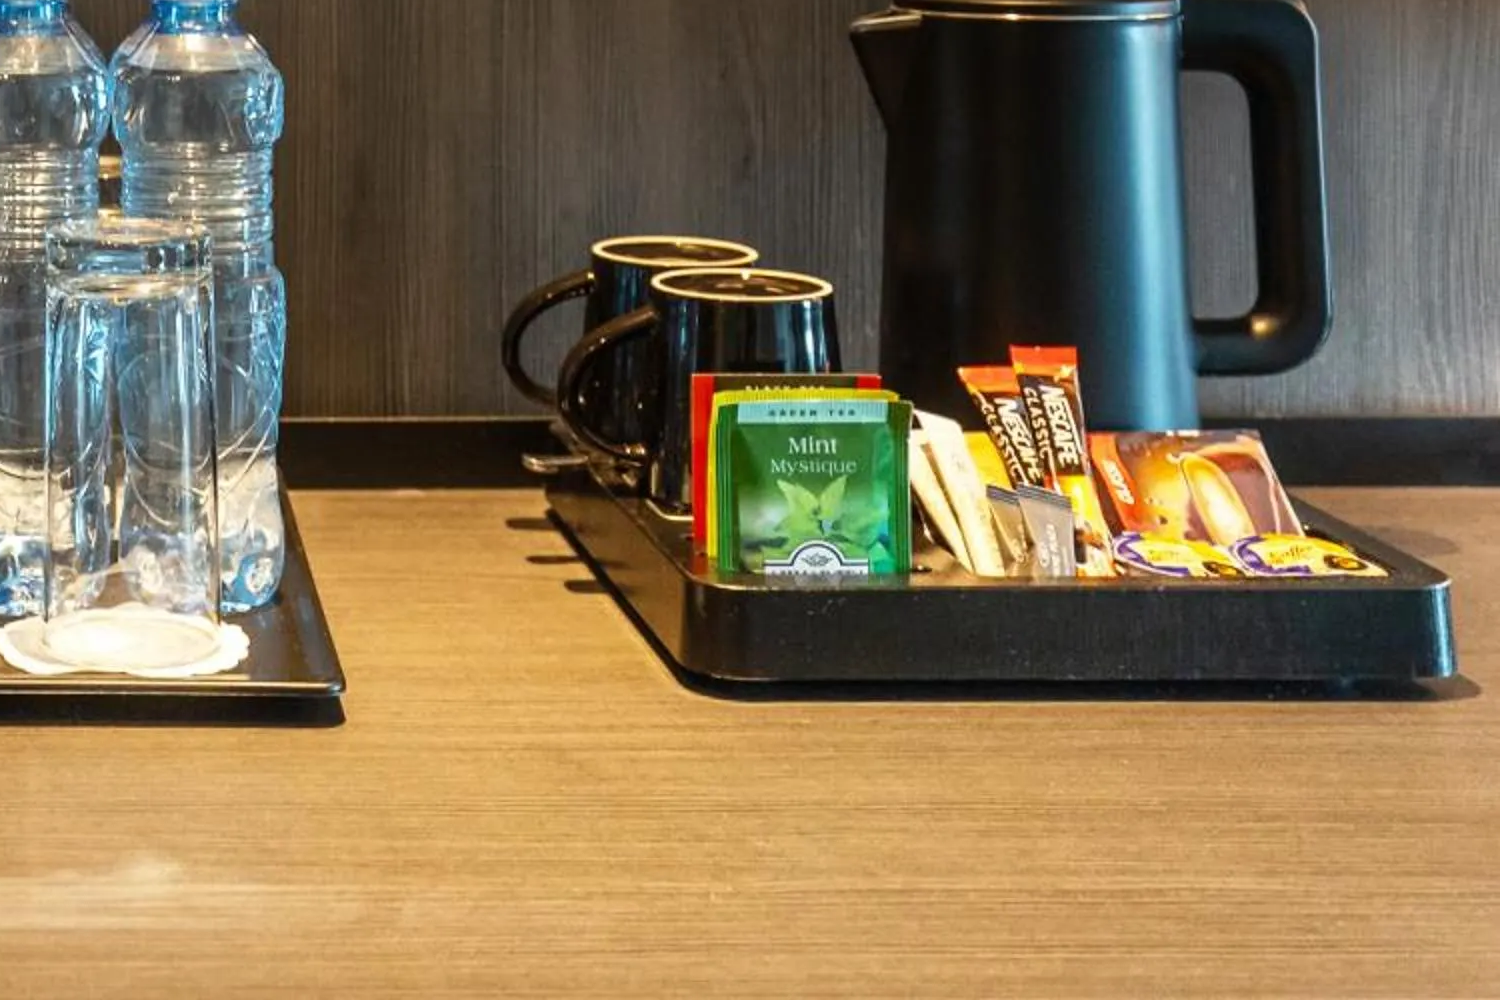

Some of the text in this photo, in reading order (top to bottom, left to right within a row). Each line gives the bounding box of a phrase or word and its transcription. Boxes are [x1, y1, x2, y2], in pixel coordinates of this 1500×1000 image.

[1023, 387, 1052, 461] CLASSIC
[788, 436, 838, 454] Mint
[770, 458, 857, 477] Mystique
